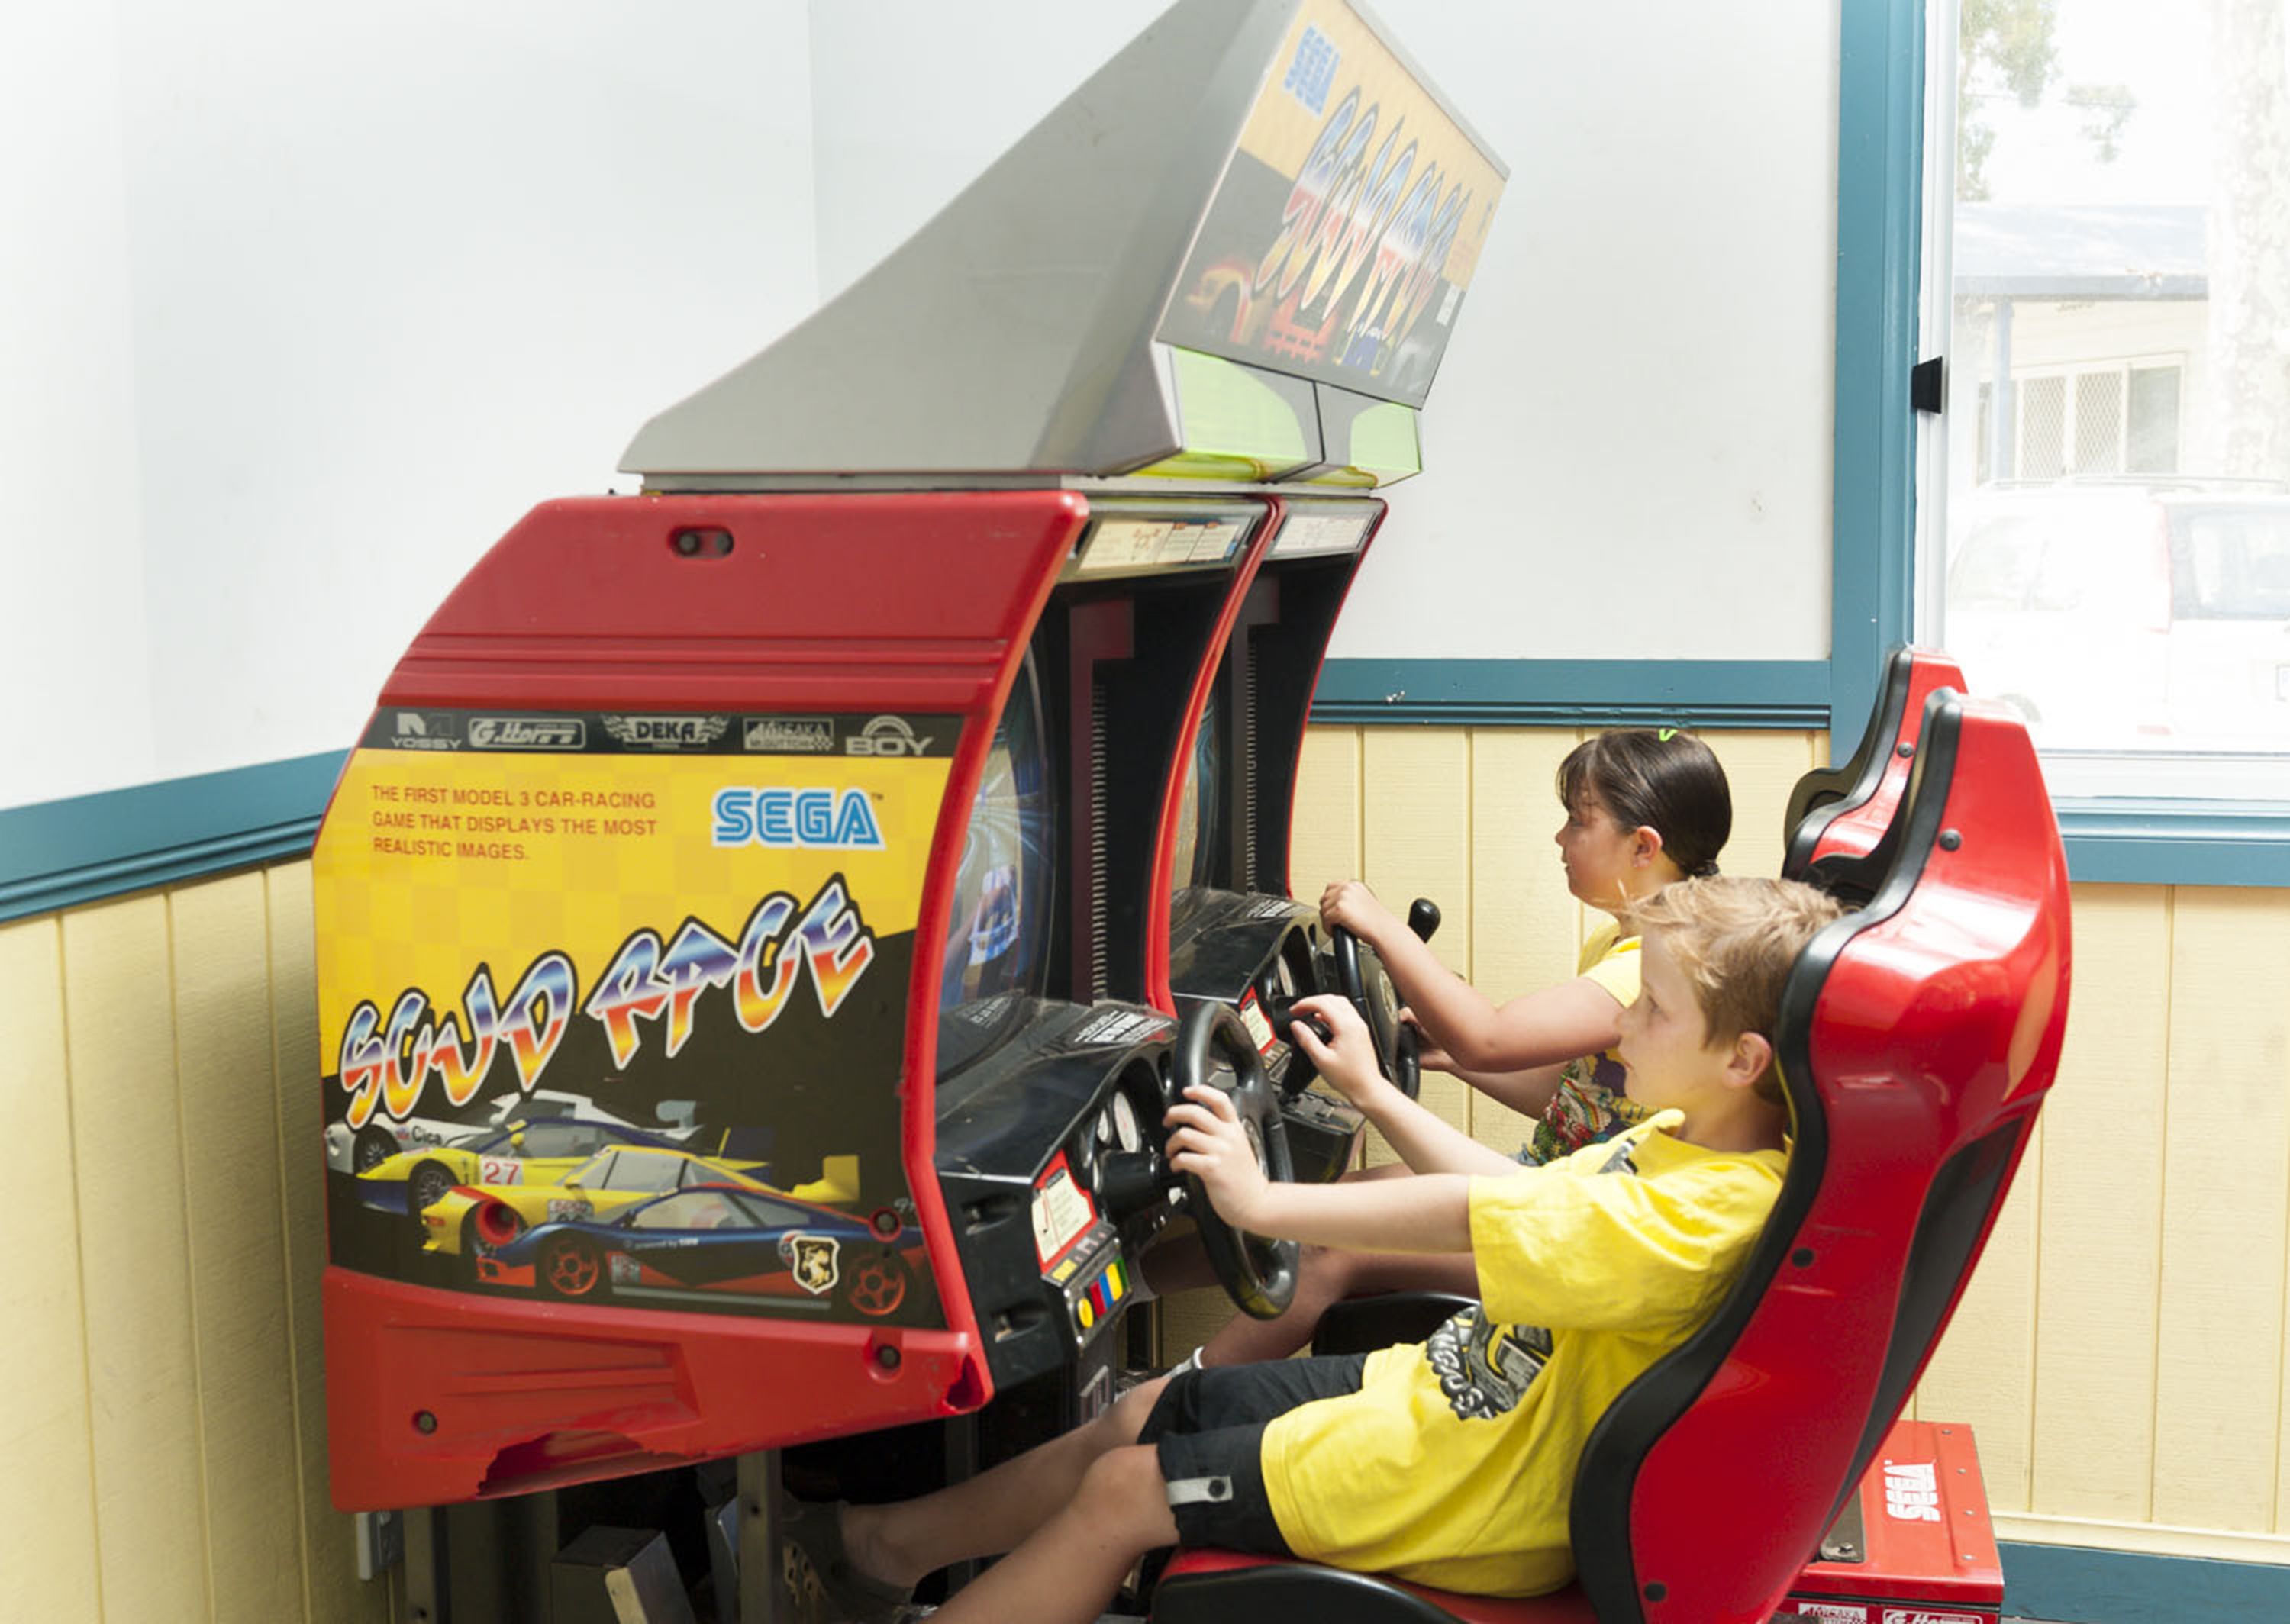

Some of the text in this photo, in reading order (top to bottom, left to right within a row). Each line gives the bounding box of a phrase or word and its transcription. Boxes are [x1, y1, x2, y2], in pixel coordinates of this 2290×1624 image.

[636, 720, 695, 740] DEKA
[845, 736, 934, 756] BOY
[373, 785, 656, 809] THE FIRST MODEL 3 CAR-RACING
[372, 810, 656, 836] GAME THAT DISPLAYS THE MOST
[714, 788, 883, 847] SEGA
[373, 837, 530, 860] REALISTIC IMAGES.
[340, 881, 875, 1130] SCUD RACE
[483, 1161, 520, 1185] 27
[1883, 1461, 1941, 1522] SEGA
